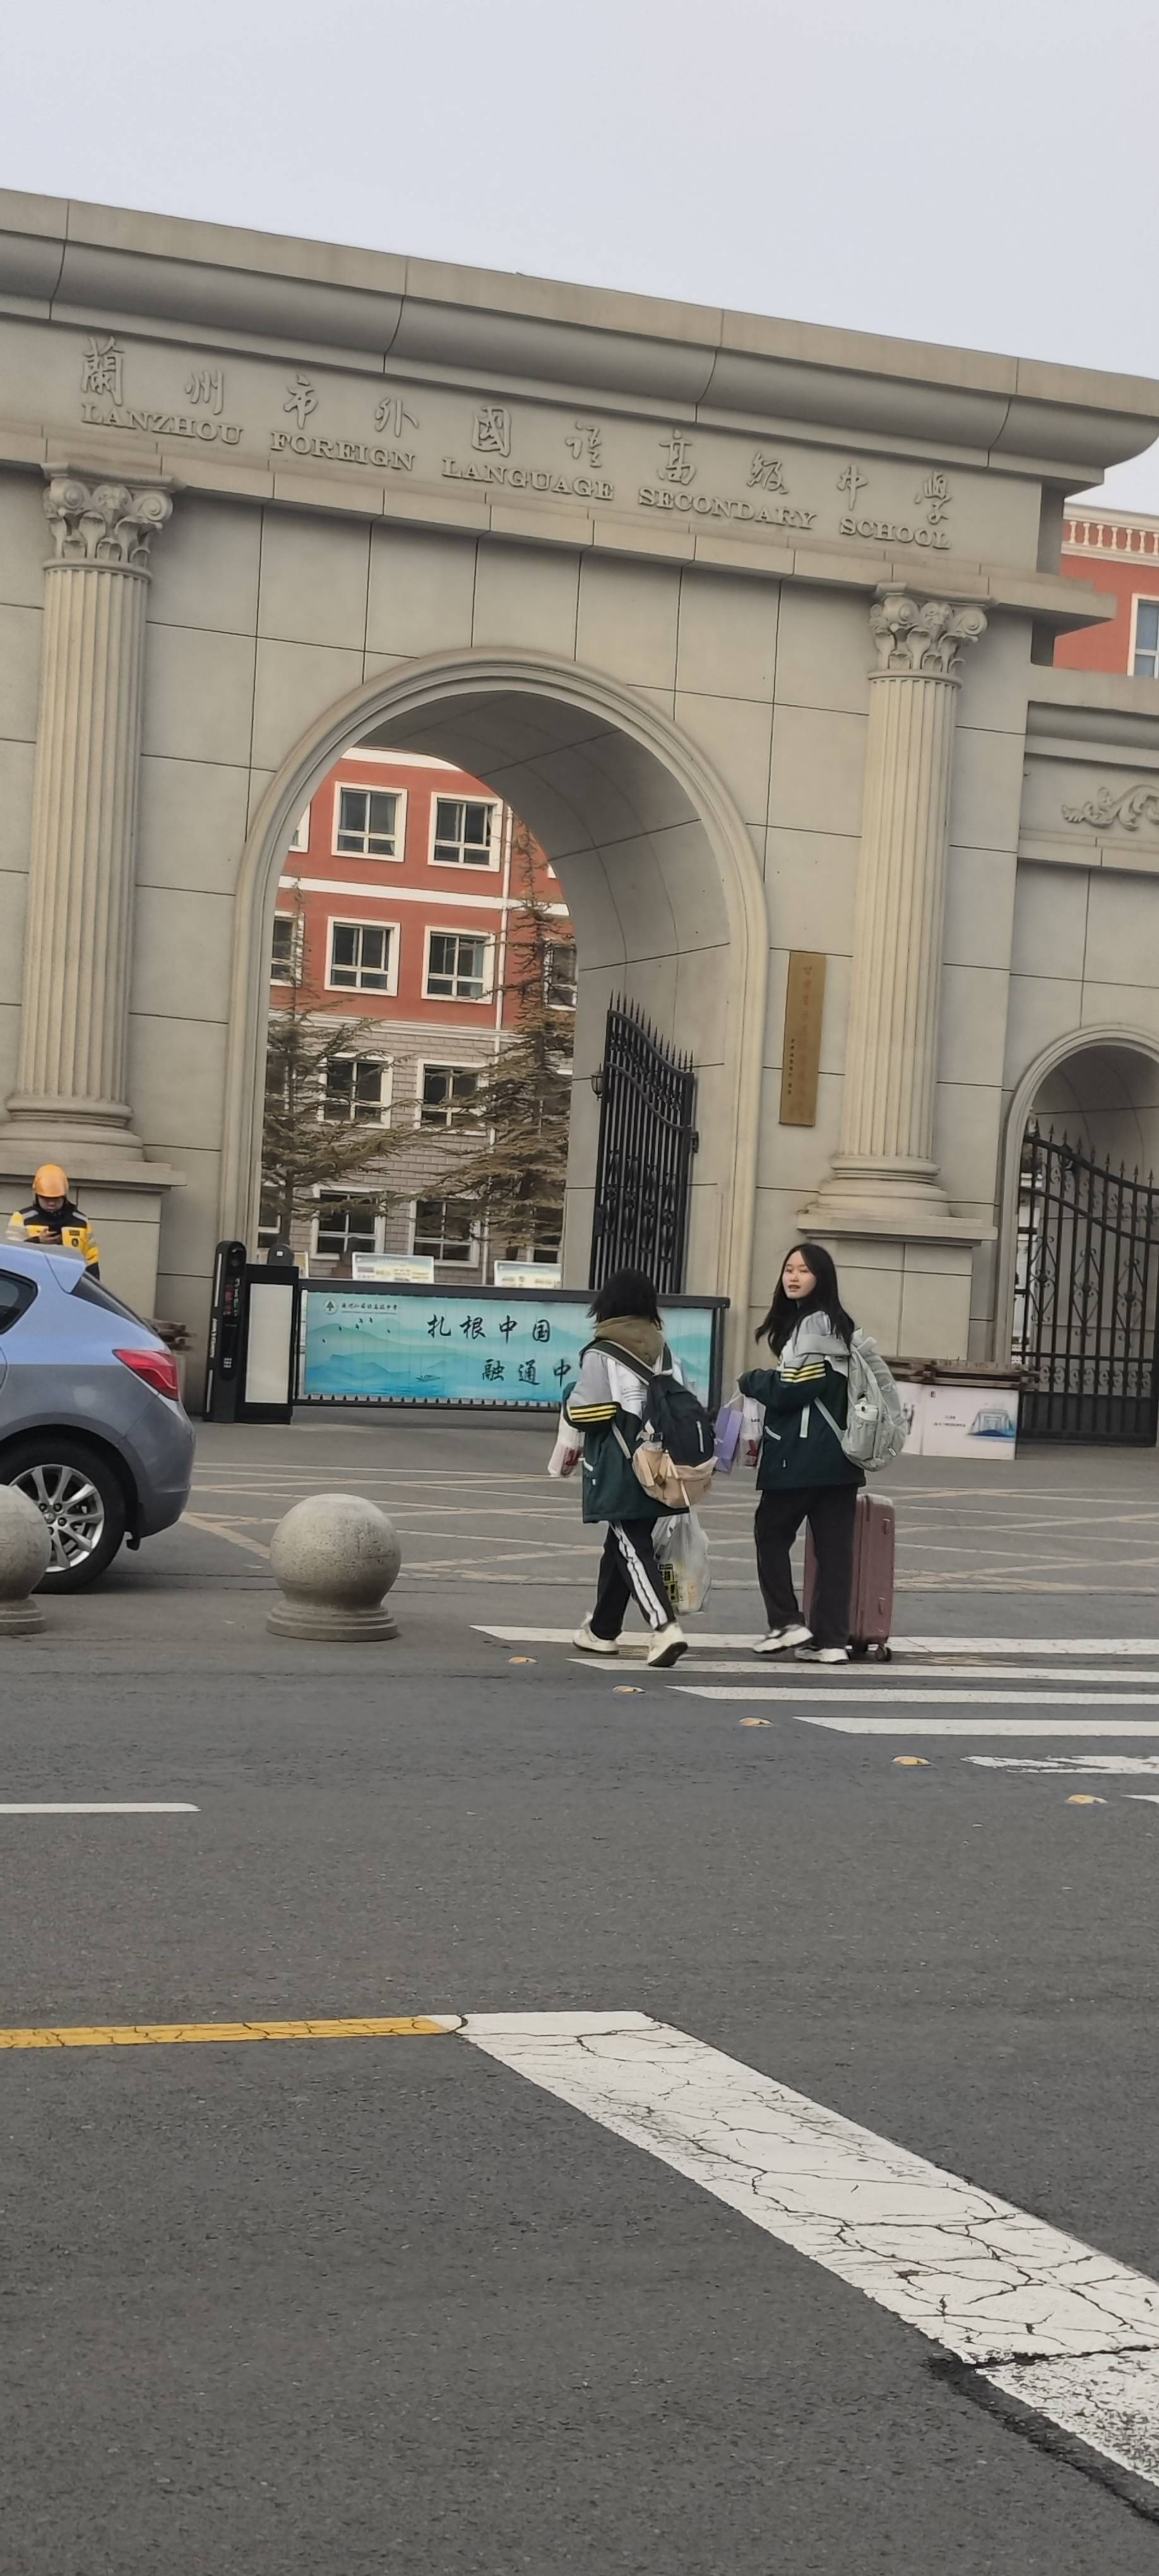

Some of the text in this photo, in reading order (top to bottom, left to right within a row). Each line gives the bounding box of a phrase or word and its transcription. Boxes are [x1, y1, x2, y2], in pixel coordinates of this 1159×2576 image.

[81, 403, 951, 550] LANZHOU FOREIGN LANGUAGE SECONDARY SCHOOL
[427, 1314, 550, 1344] 扎根中国
